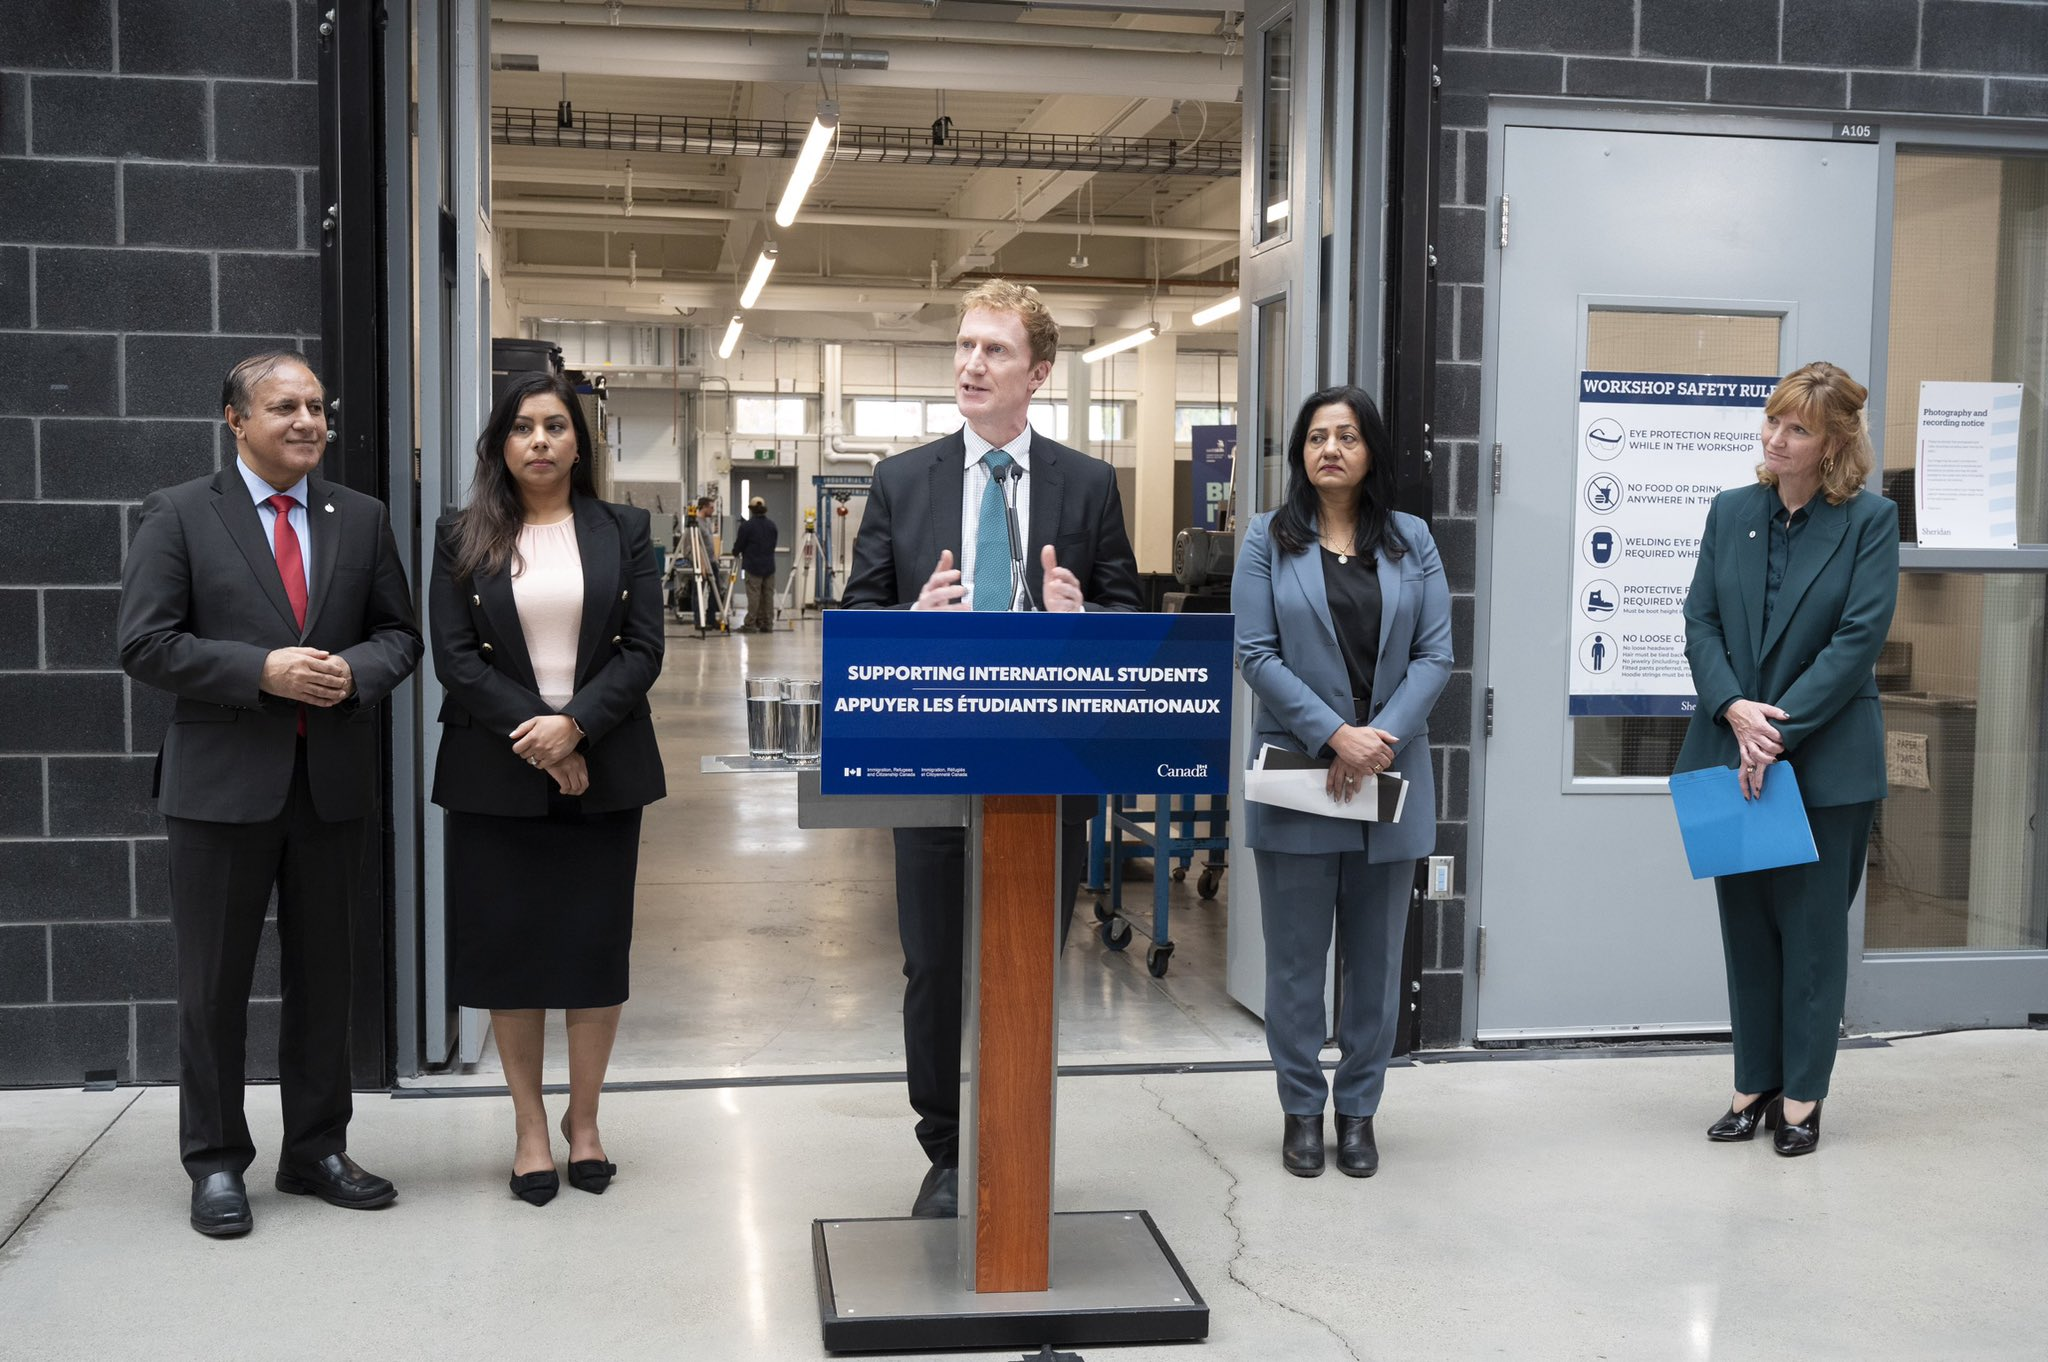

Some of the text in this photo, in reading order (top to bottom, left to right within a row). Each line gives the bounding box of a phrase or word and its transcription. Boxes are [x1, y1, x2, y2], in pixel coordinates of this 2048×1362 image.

[1841, 125, 1871, 137] A105
[1583, 379, 1675, 395] WORKSHOP
[1677, 381, 1737, 397] SAFETY
[1923, 408, 1988, 418] Photography and
[1922, 419, 1960, 428] recording
[1630, 429, 1761, 442] EYE PROTECTION REQUIRED
[1629, 441, 1754, 452] WHILE IN THE WORKSHOP
[1627, 484, 1721, 493] NO FOOD OR DRINK
[1627, 495, 1682, 504] ANYWHERE
[1921, 527, 1952, 536] Sheridan
[1625, 538, 1671, 546] WELDING
[1673, 539, 1691, 547] EYE
[1625, 549, 1675, 559] REQUIRED
[1623, 585, 1682, 594] PROTECTIVE
[1623, 597, 1673, 606] REQUIRED
[1622, 633, 1637, 642] NO
[1640, 634, 1671, 643] LOOSE
[847, 665, 1208, 682] SUPPORTING INTERNATIONAL STUDENTS
[834, 694, 1221, 714] APPUYER LES ÉTUDIANTS INTERNATIONAUX
[1895, 753, 1923, 765] TOWELS
[1157, 763, 1208, 777] Canada
